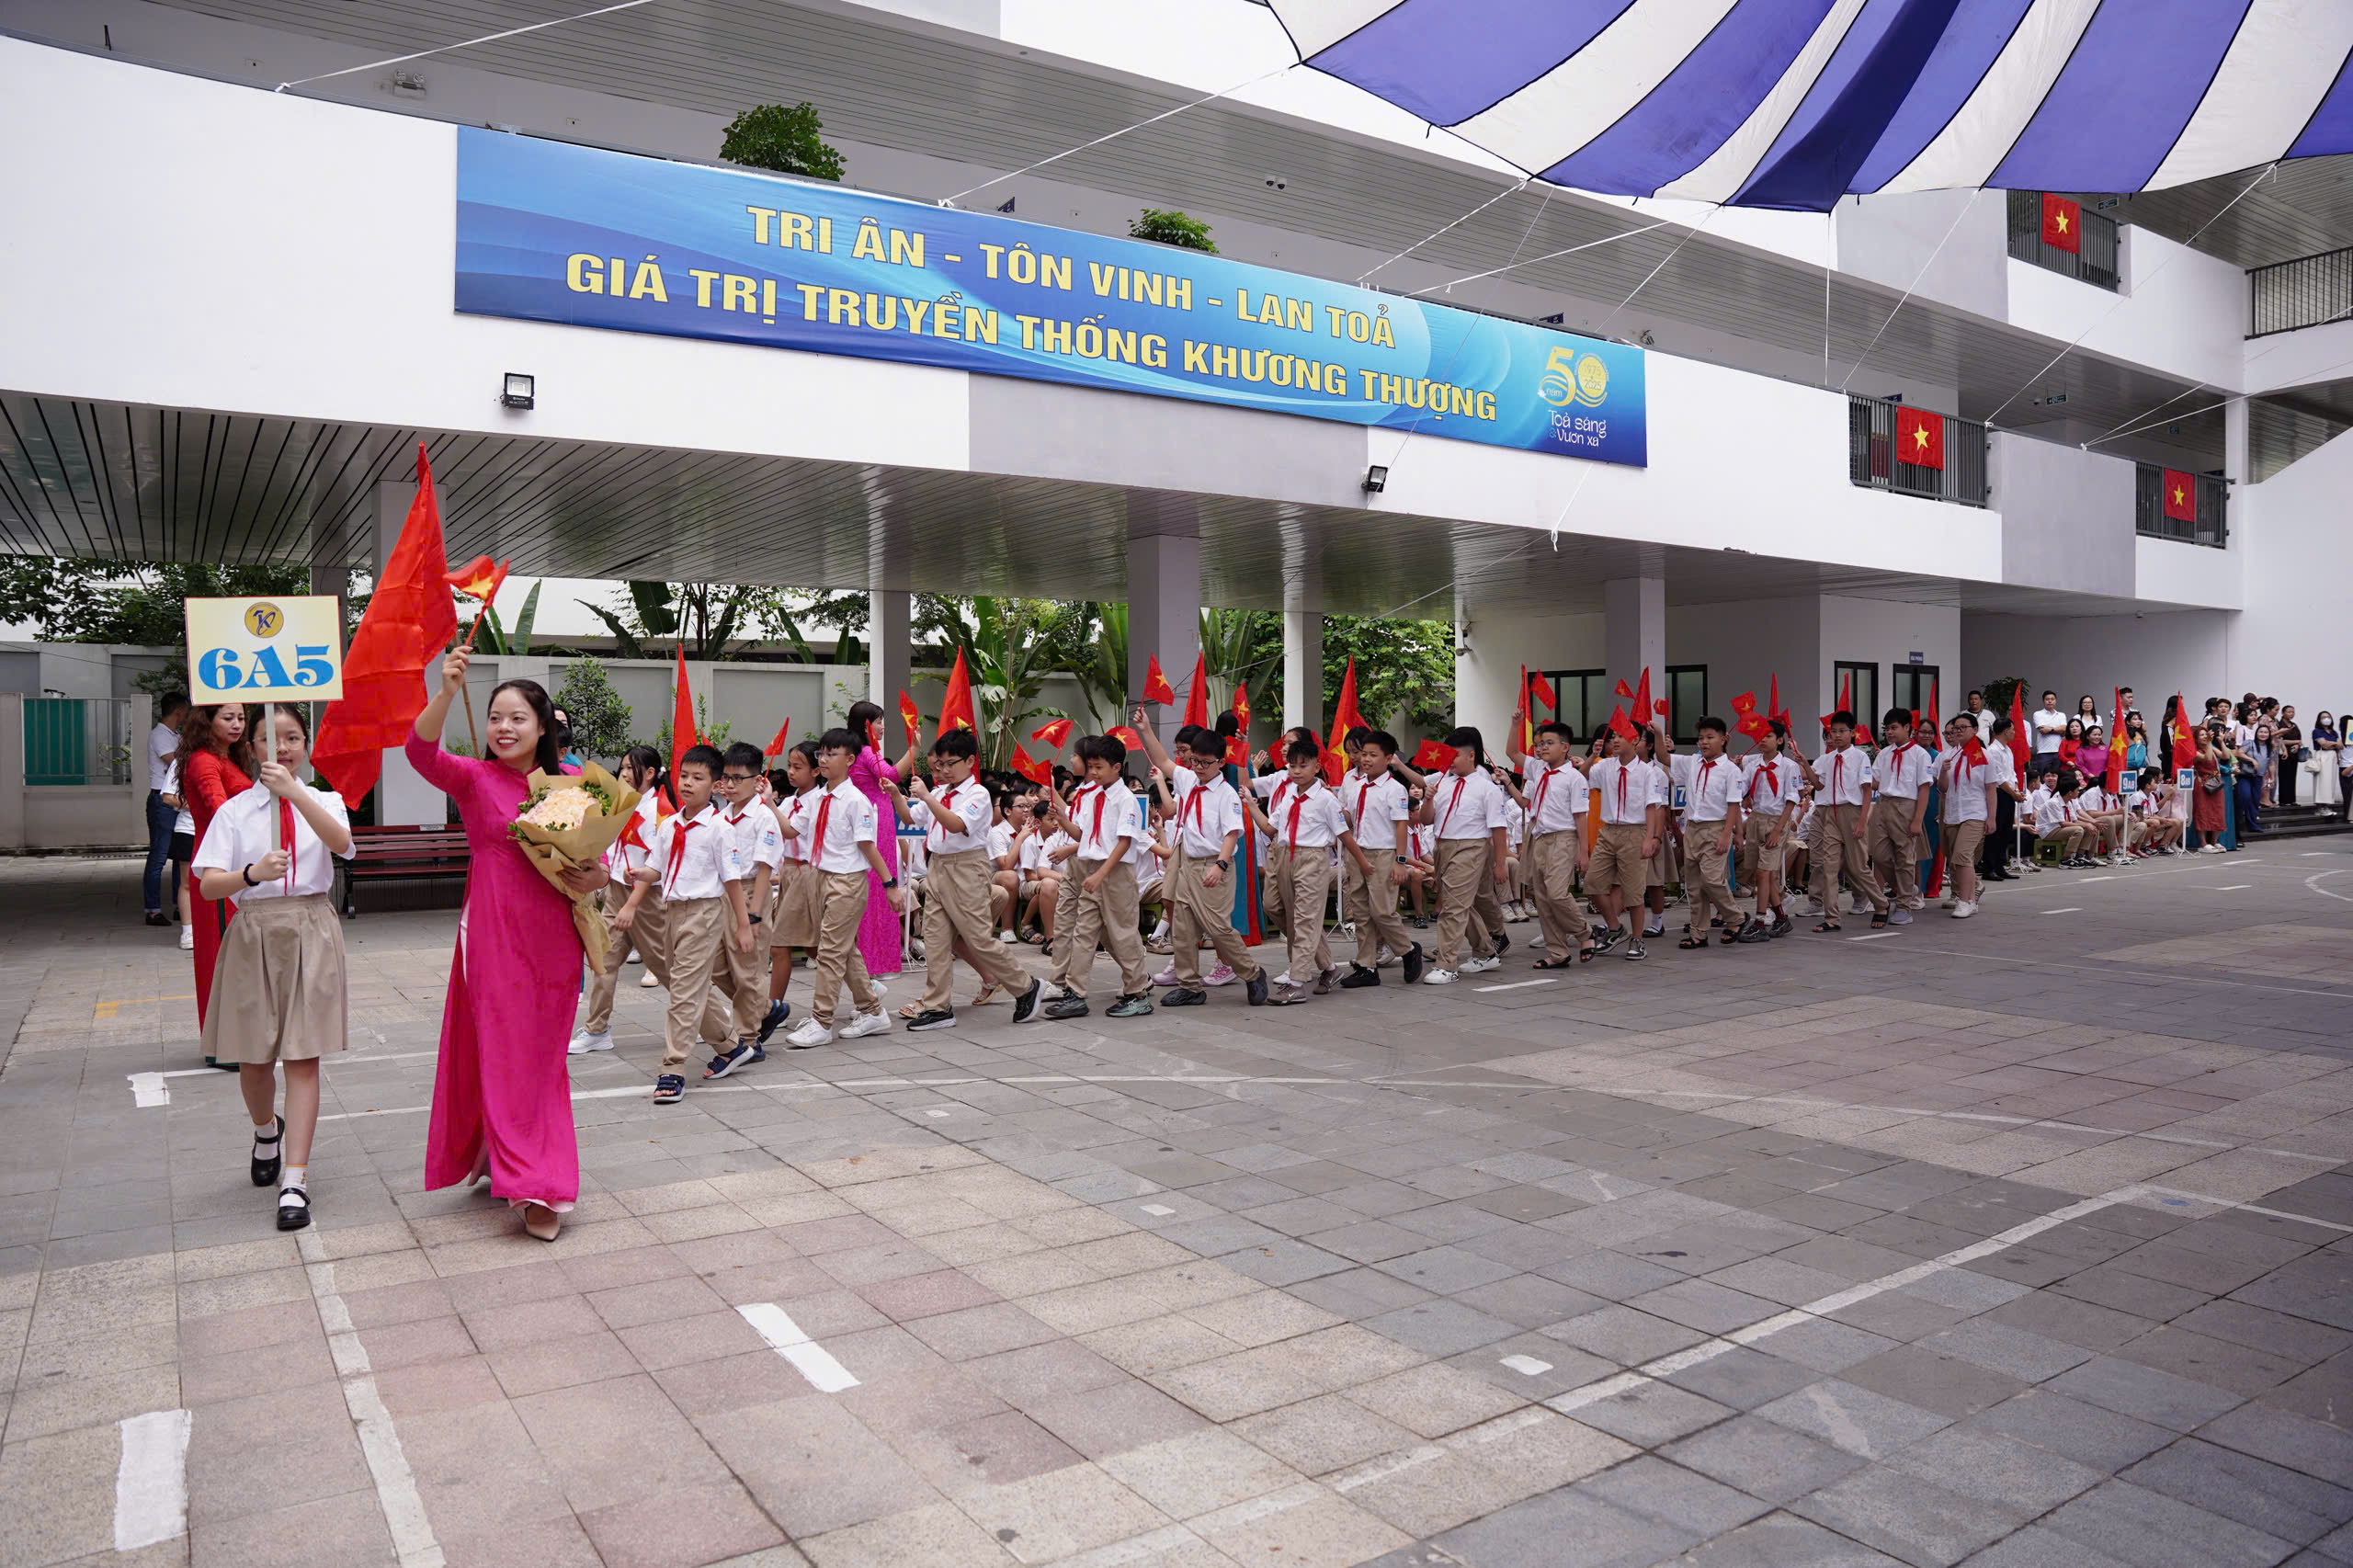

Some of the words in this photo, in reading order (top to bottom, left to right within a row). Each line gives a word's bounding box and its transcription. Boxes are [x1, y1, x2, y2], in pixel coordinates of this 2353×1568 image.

[747, 205, 833, 255] TRI
[851, 216, 926, 268] ÂN
[979, 242, 1073, 292] TÔN
[1089, 262, 1192, 312] VINH
[1237, 288, 1313, 333] LAN
[1325, 304, 1395, 348] TOẢ
[566, 252, 668, 303] GIÁ
[688, 268, 777, 325] TRỊ
[795, 282, 999, 346] TRUYỀN
[1015, 312, 1167, 368] THỐNG
[1182, 339, 1347, 395] KHƯƠNG
[1359, 369, 1496, 424] THƯỢNG
[1548, 409, 1571, 429] Toả
[1574, 416, 1608, 439] sáng
[1586, 436, 1599, 448] xa
[198, 643, 335, 690] 6A5
